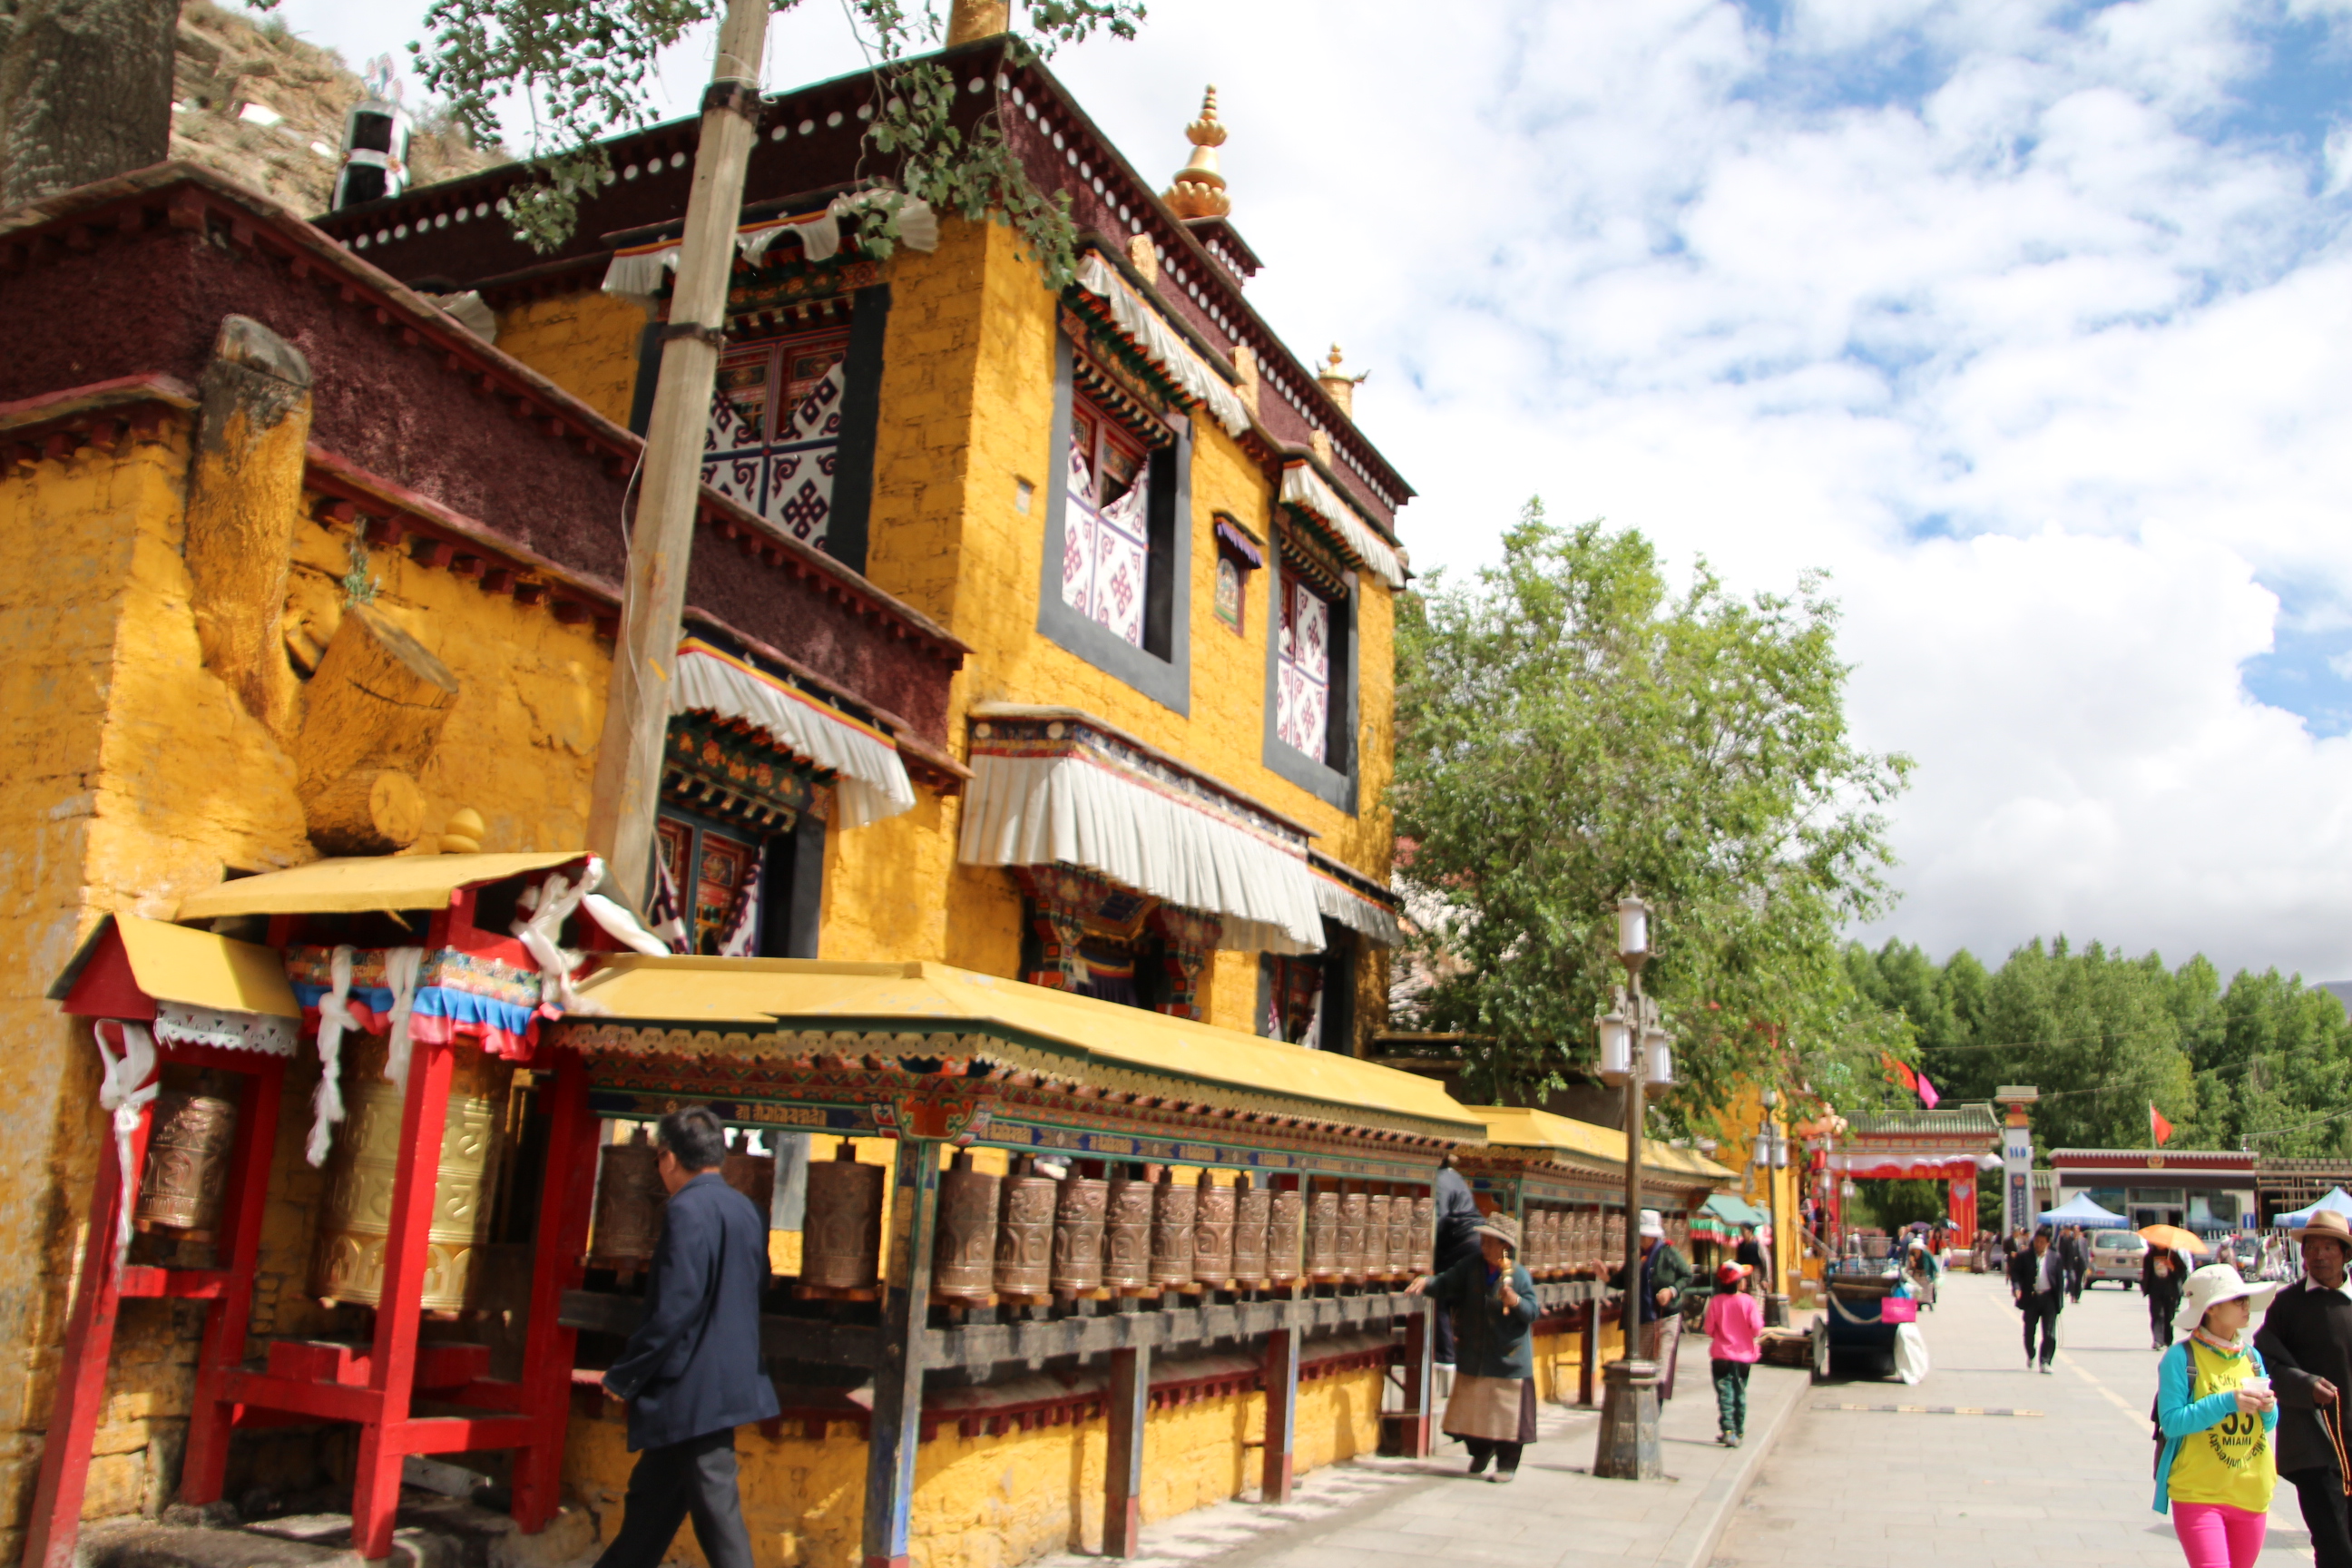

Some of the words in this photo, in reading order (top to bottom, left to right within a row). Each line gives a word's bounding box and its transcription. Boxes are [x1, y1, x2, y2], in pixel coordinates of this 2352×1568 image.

[2009, 1147, 2026, 1158] 110
[2218, 1374, 2236, 1387] City
[2222, 1436, 2251, 1446] MIAMI
[2209, 1434, 2241, 1468] University
